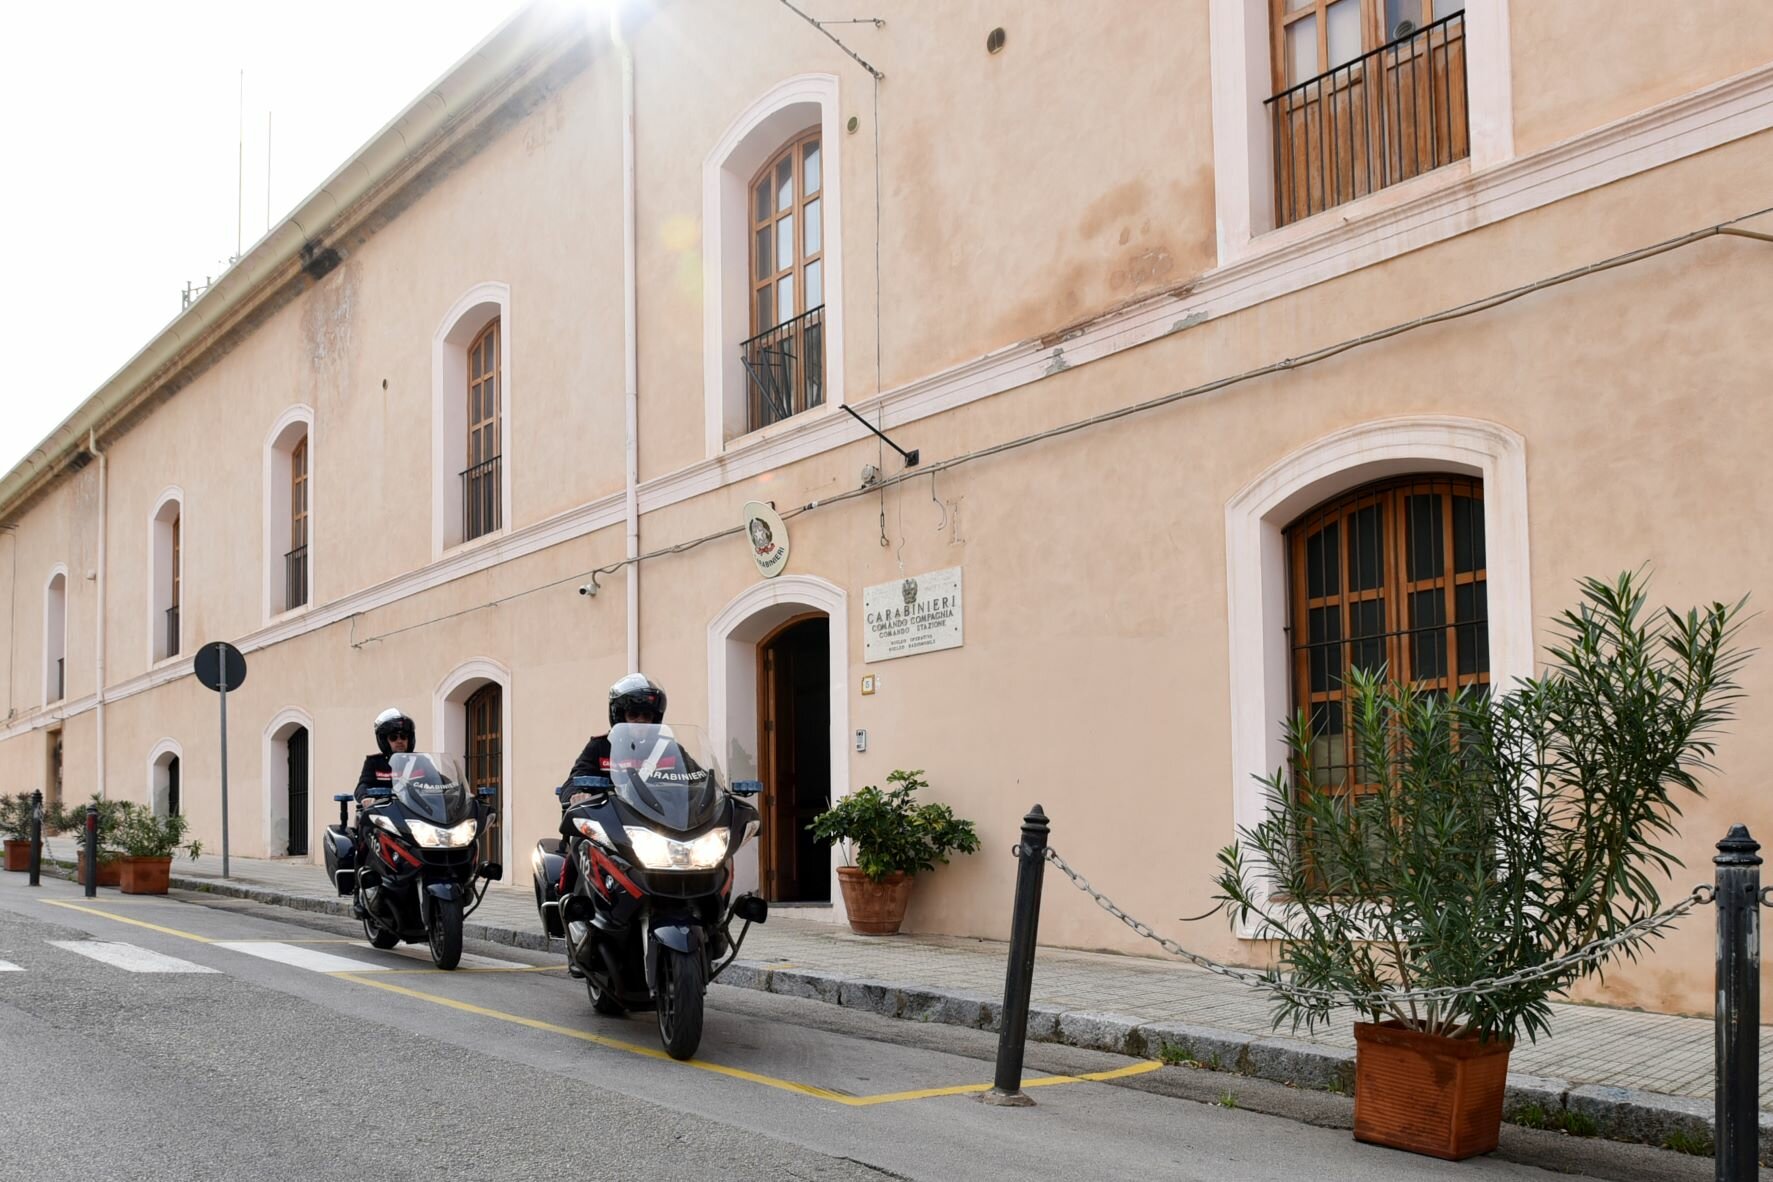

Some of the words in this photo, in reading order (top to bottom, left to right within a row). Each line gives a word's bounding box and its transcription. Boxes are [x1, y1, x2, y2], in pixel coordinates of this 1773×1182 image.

[867, 594, 955, 625] CARABINIERI
[872, 618, 908, 633] COMANDO
[910, 608, 954, 625] COMPAGNIA
[879, 627, 910, 639] COMANDO
[917, 620, 946, 632] STAZIONE
